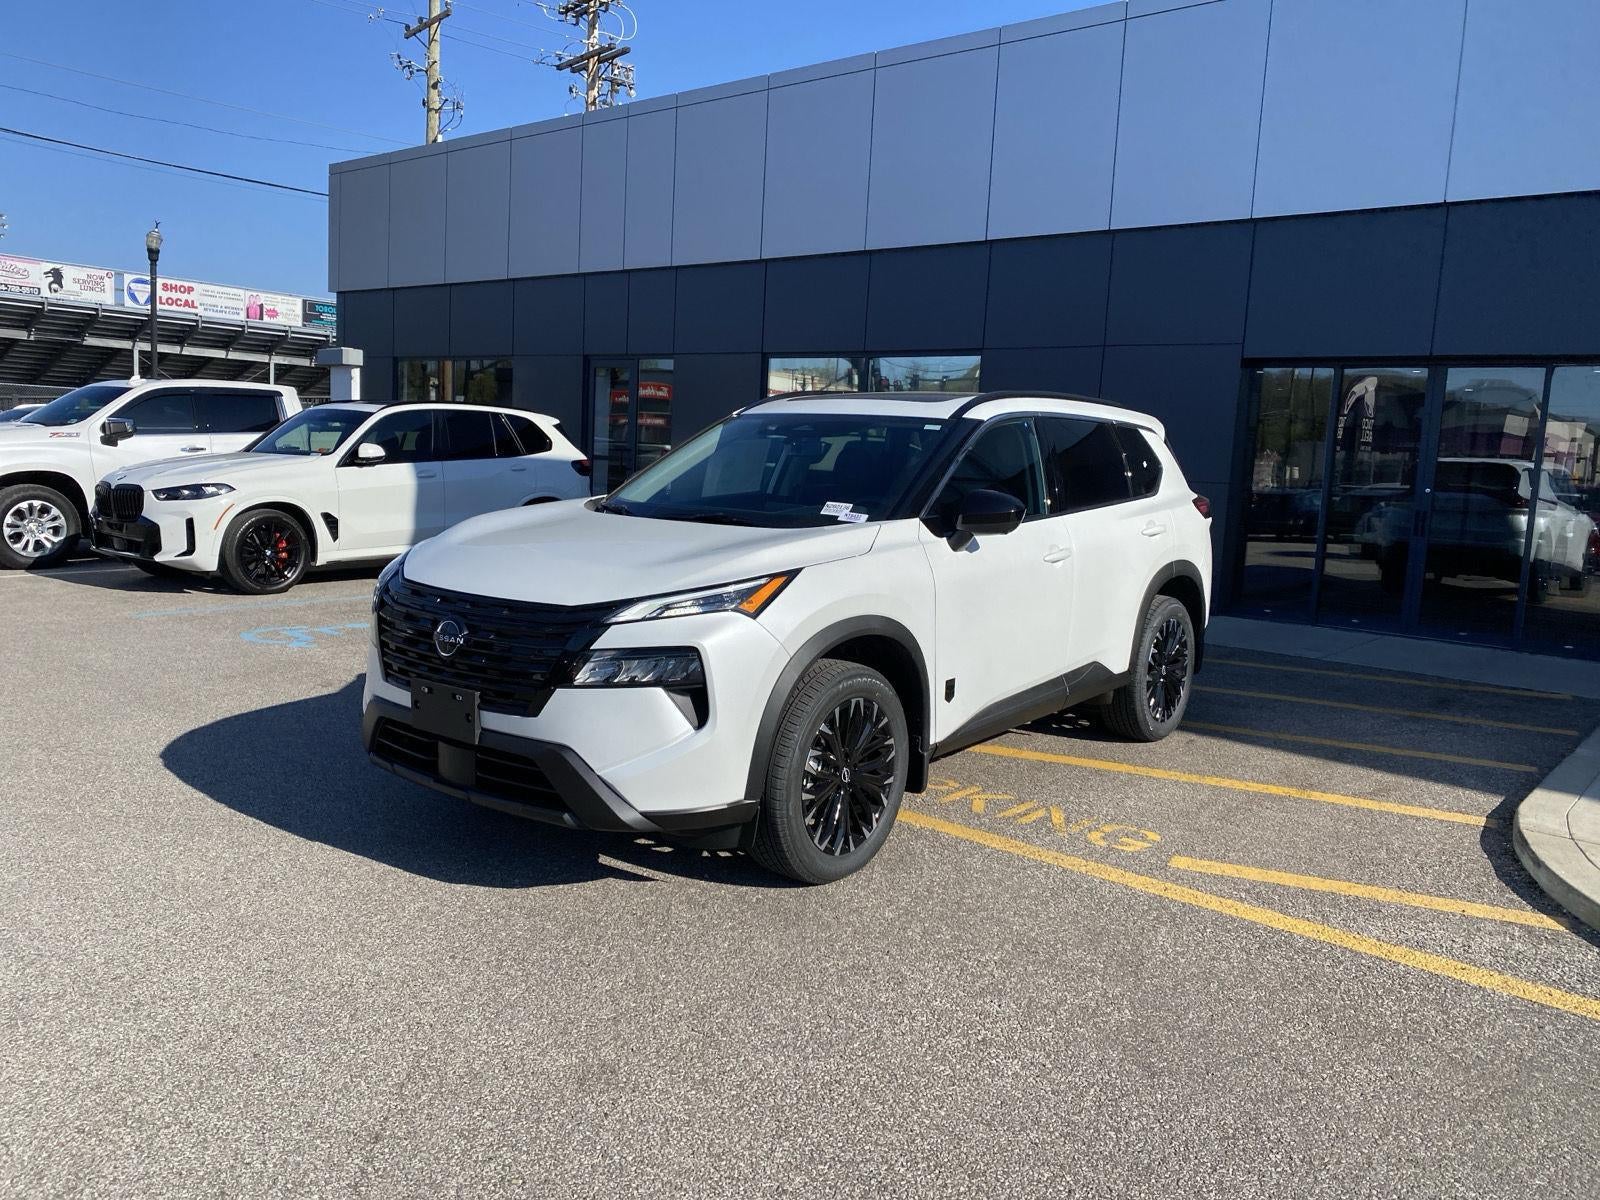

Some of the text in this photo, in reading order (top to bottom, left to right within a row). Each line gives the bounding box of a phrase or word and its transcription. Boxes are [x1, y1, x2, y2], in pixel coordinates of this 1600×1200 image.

[86, 273, 105, 281] NOW
[72, 278, 105, 288] SERVING
[161, 282, 195, 295] SHOP
[158, 295, 198, 309] LOCAL
